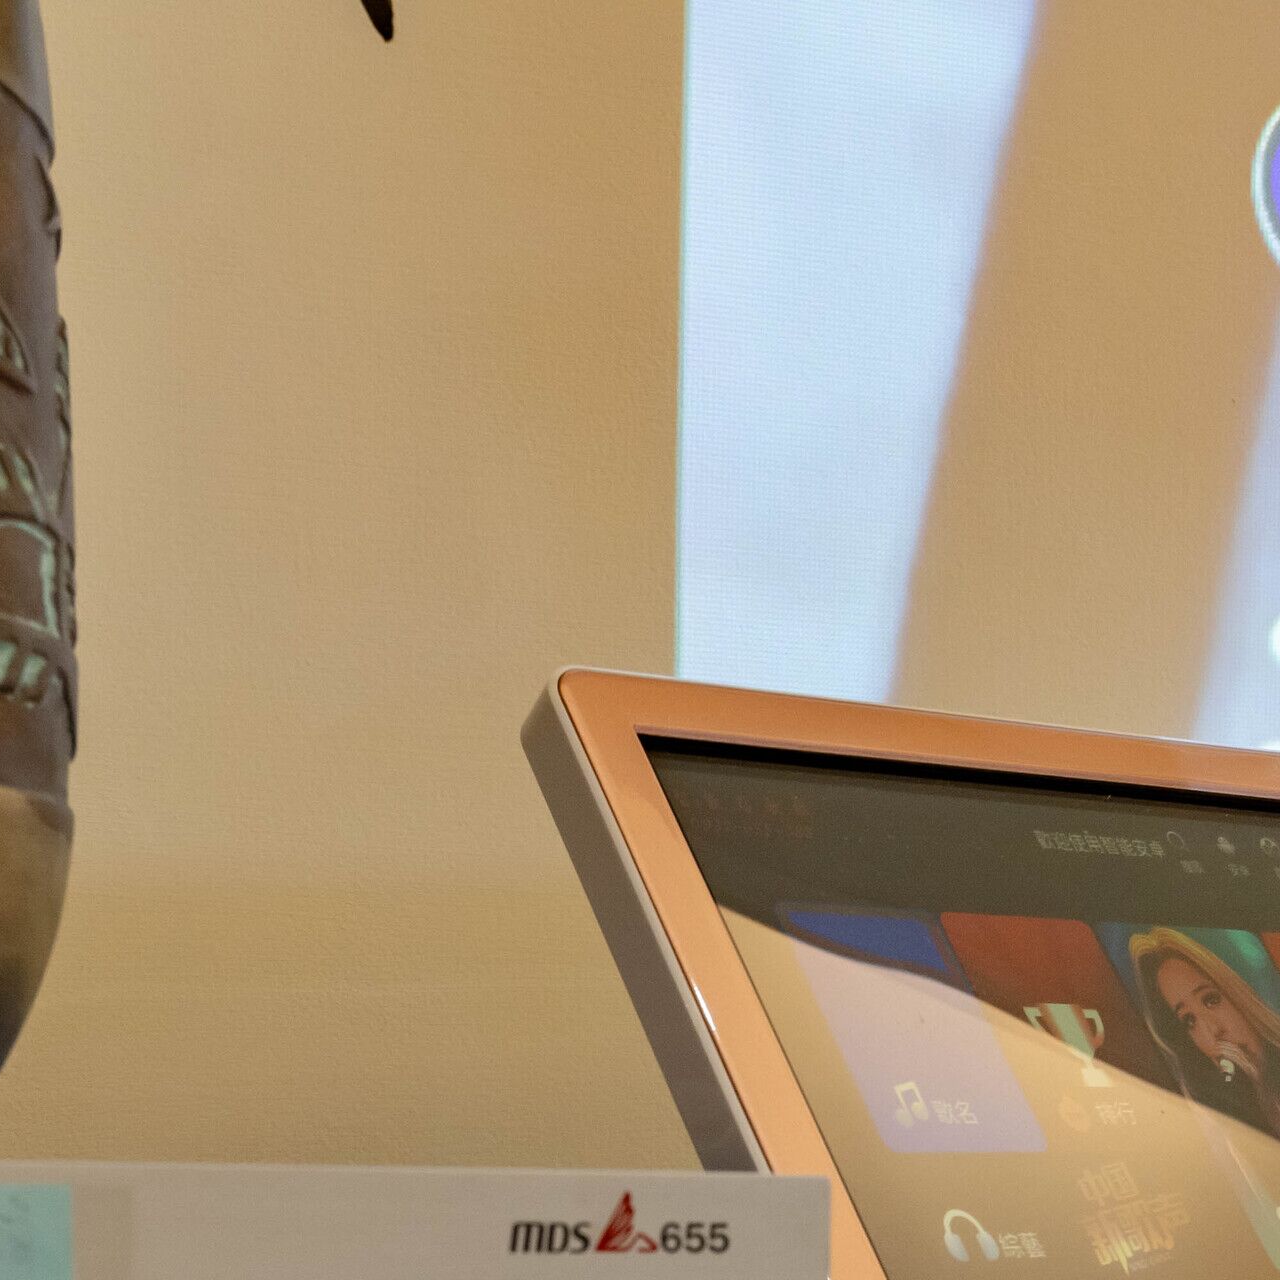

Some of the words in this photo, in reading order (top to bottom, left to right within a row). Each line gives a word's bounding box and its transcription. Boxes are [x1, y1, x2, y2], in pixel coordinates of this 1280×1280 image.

[932, 1099, 979, 1125] 歌名
[1077, 1161, 1139, 1208] 中国
[659, 1222, 732, 1255] 655
